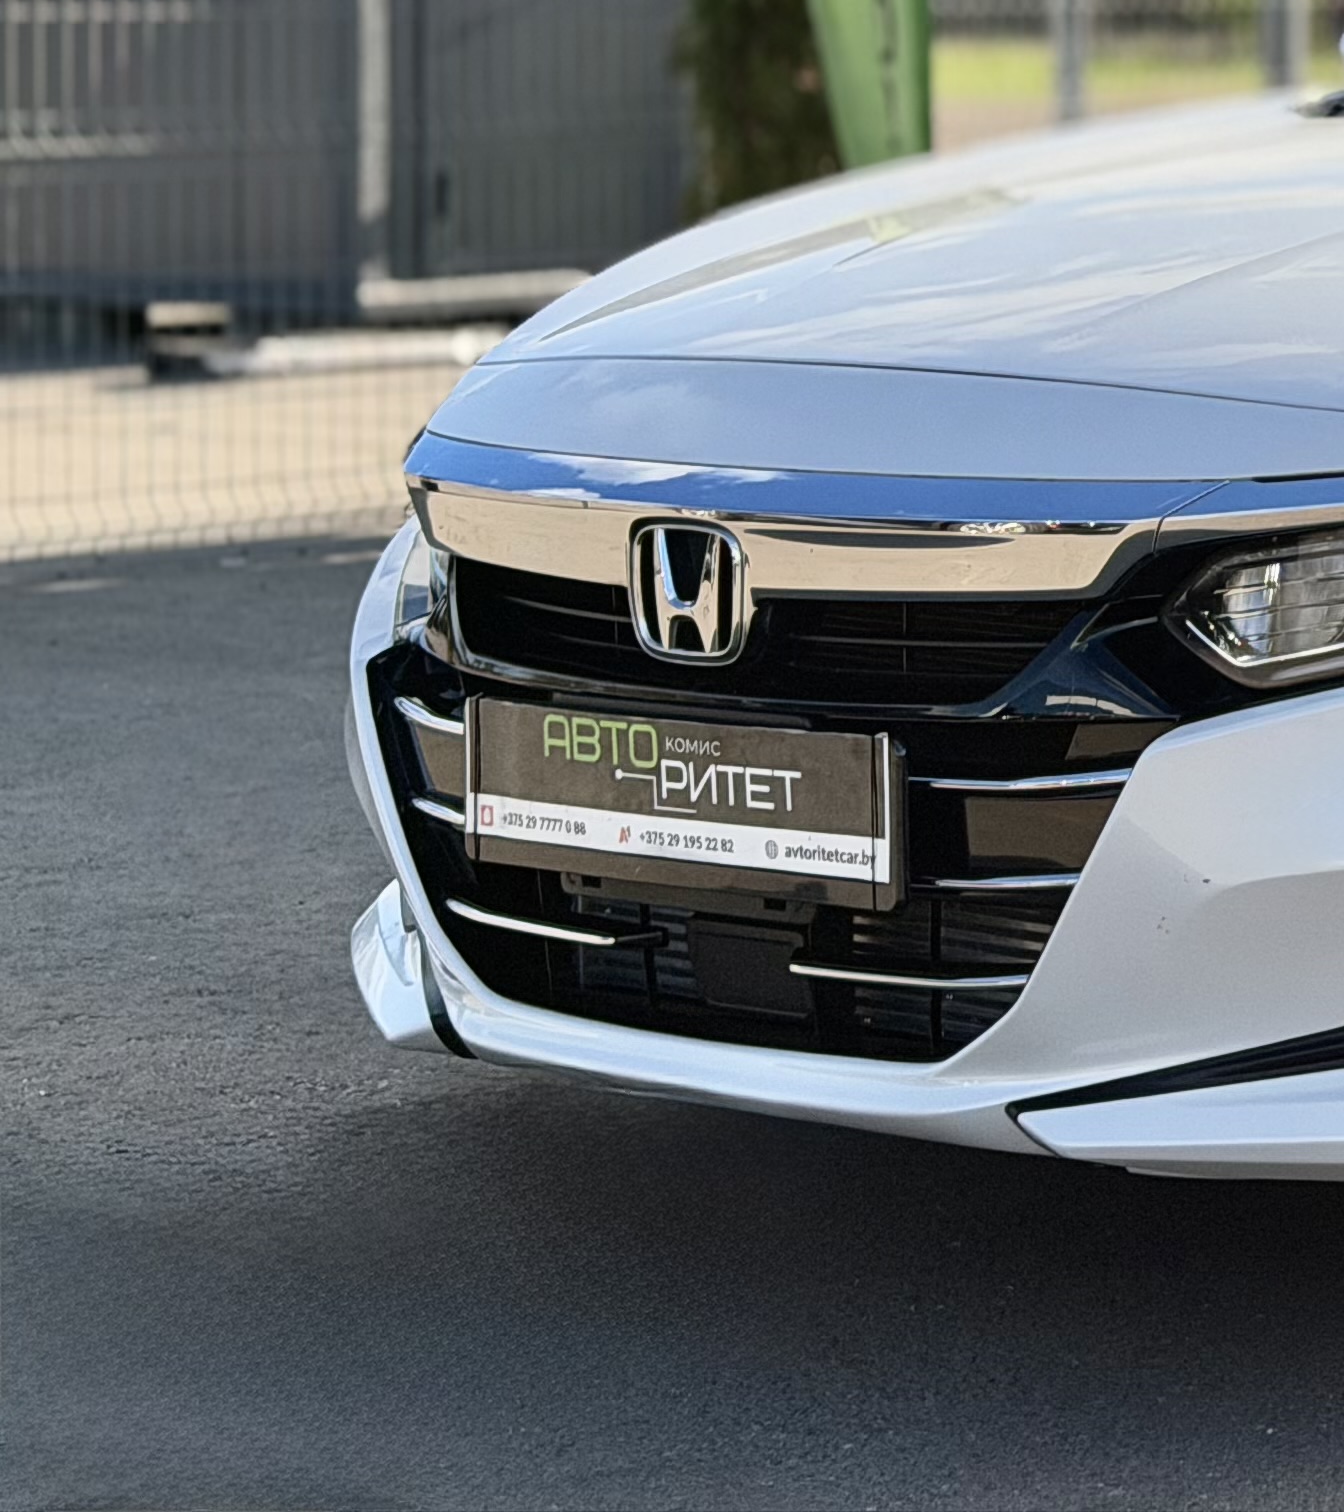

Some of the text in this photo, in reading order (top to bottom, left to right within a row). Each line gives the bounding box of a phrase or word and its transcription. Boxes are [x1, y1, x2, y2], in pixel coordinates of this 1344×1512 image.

[543, 713, 659, 769] АВТО
[665, 736, 721, 757] КОМИС
[660, 758, 802, 812] РИТЕТ
[501, 812, 524, 828] +375
[525, 814, 538, 830] 29
[539, 816, 564, 833] 7777
[639, 830, 735, 854] +375 29 195 22 82
[784, 844, 876, 869] avtoritetcar.by
